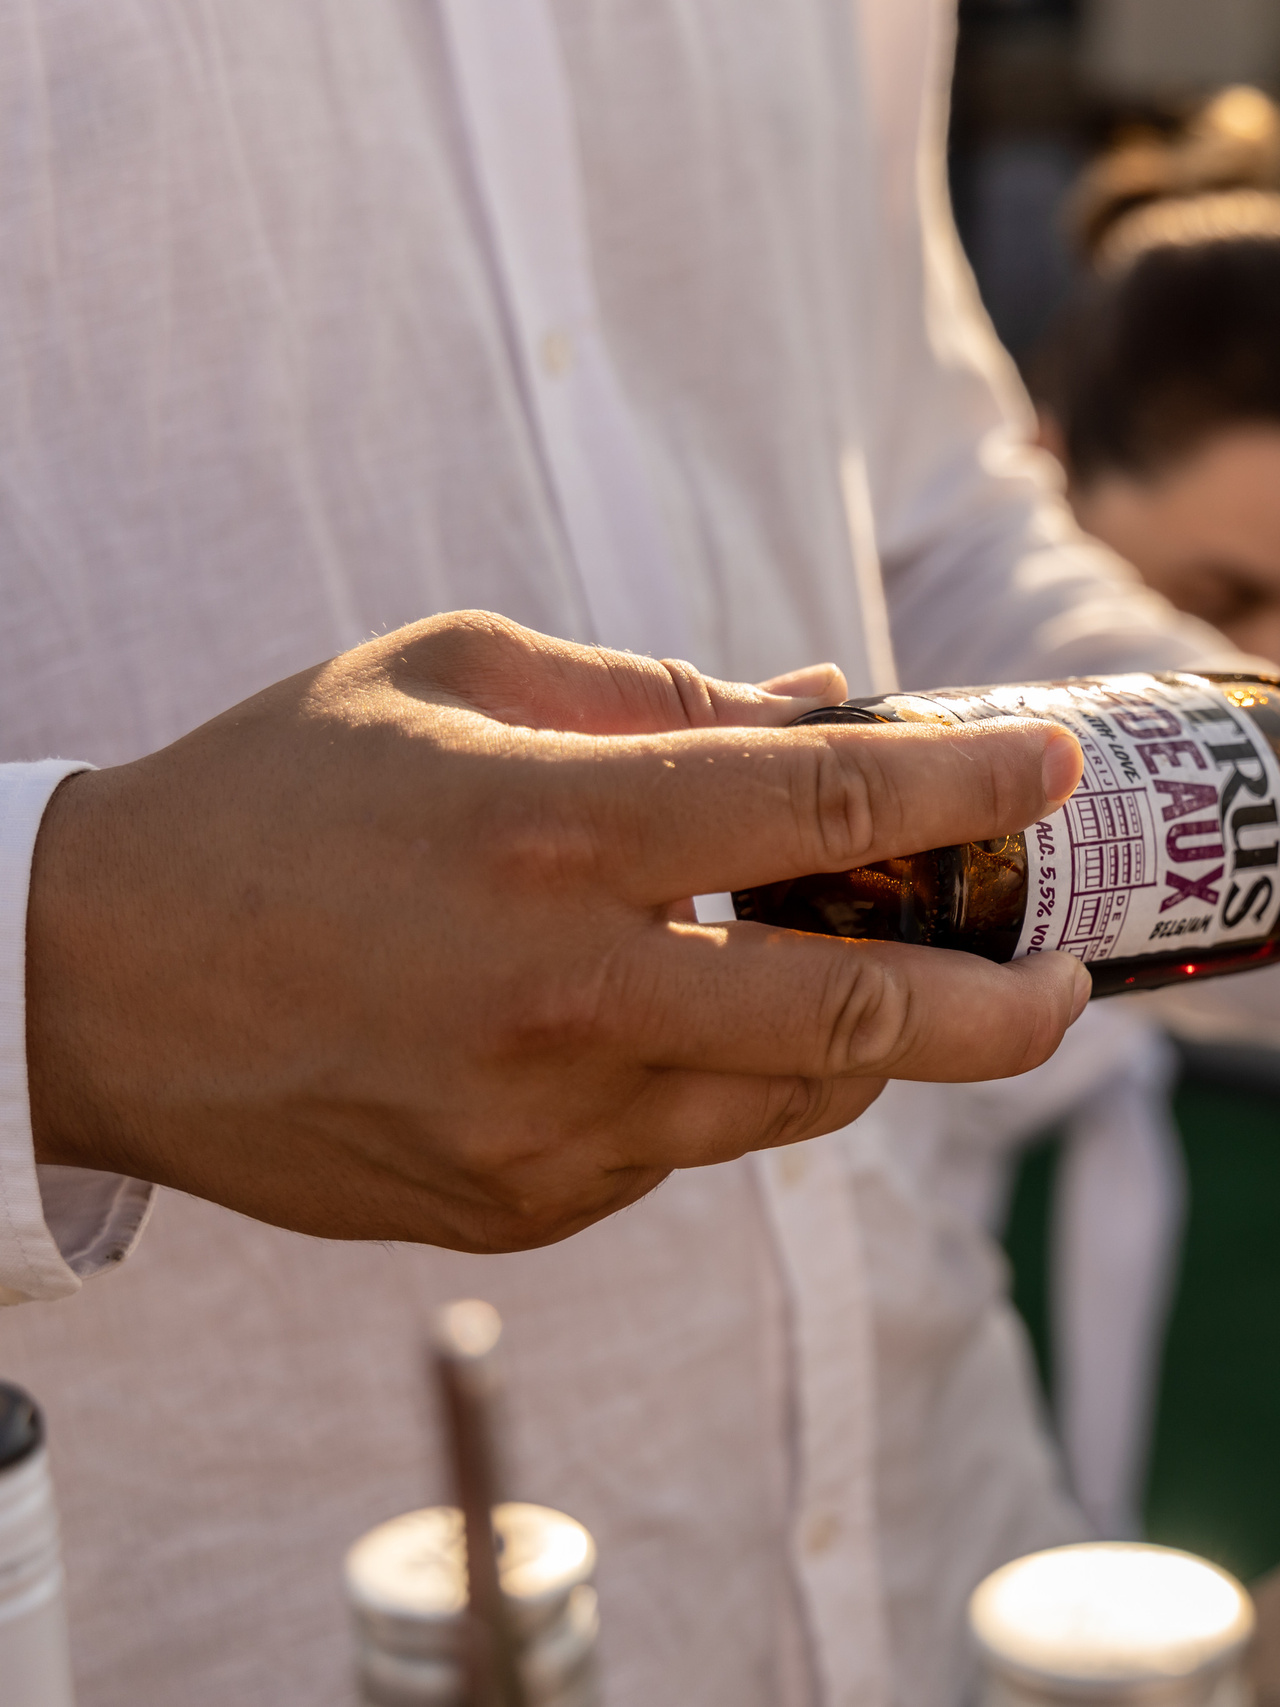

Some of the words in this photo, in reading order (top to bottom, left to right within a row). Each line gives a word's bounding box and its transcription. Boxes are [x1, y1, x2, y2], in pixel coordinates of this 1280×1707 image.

[1108, 743, 1142, 784] LOVE
[1181, 698, 1280, 930] TRUS
[1034, 820, 1056, 862] ALC.
[1034, 866, 1057, 918] 5,5%
[1112, 894, 1126, 922] DE
[1148, 914, 1213, 941] BELGIUM
